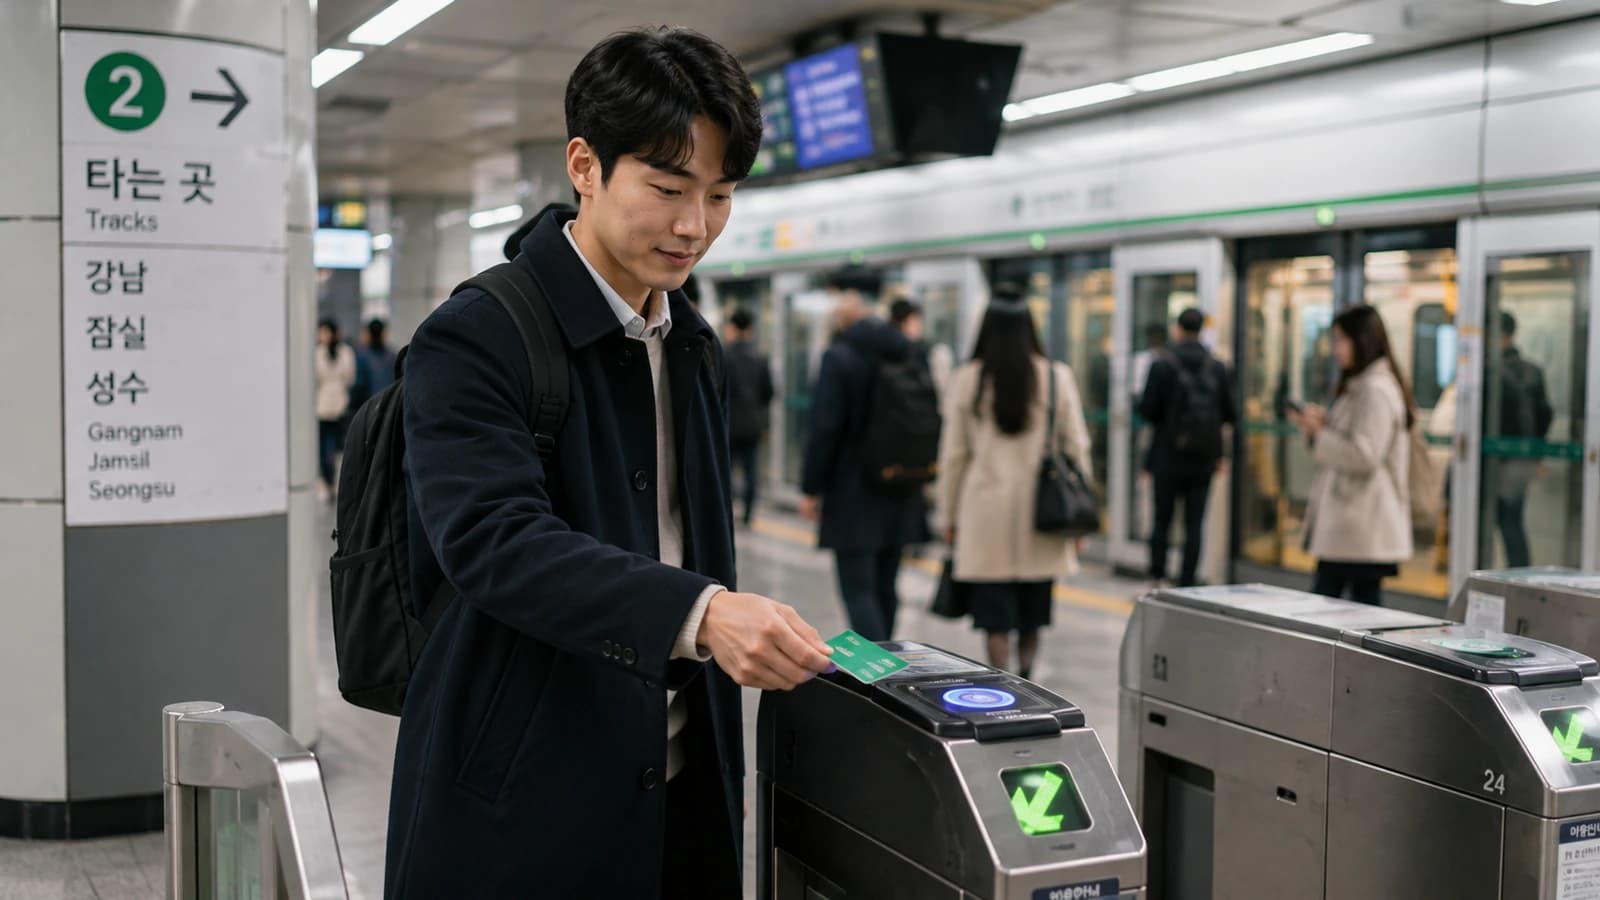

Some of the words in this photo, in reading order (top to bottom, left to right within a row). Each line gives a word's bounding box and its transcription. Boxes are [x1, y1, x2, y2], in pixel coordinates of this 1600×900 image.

[109, 65, 144, 118] 2
[86, 157, 166, 202] 타는
[180, 161, 216, 204] 곳
[86, 208, 159, 232] Tracks
[86, 260, 148, 295] 강남
[86, 315, 147, 350] 잠실
[87, 371, 149, 406] 성수
[87, 422, 184, 446] Gangnam
[88, 451, 150, 471] Jamsil
[89, 480, 176, 503] Seongsu
[1483, 769, 1505, 796] 24
